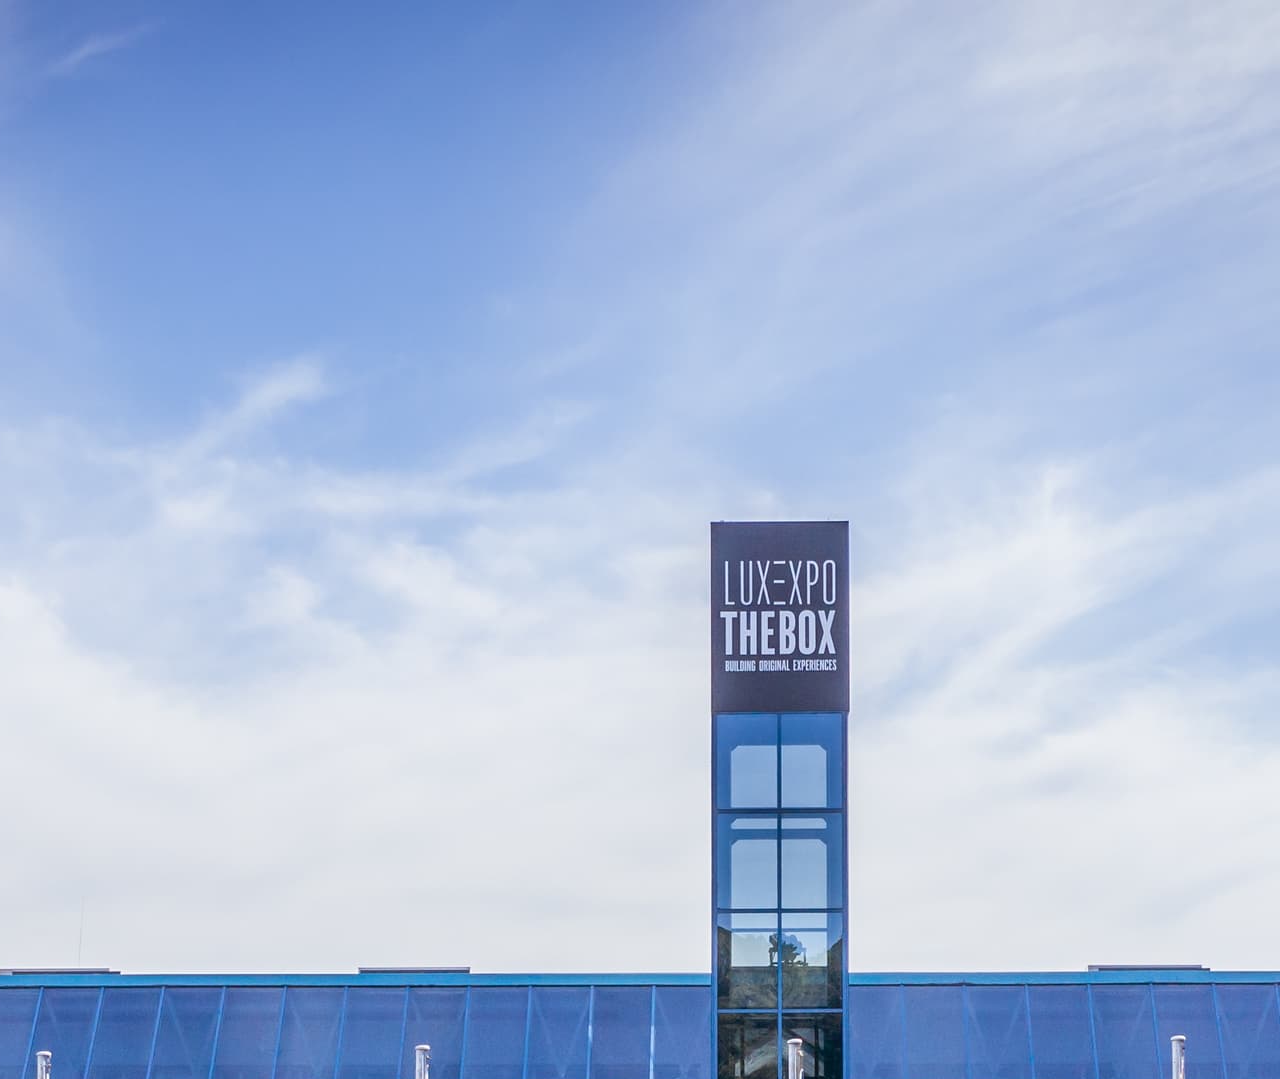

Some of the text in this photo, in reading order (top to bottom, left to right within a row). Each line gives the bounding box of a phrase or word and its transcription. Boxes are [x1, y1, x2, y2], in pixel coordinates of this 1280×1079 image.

[724, 659, 837, 672] BUILDING ORIGINAL EXPERIENCES
